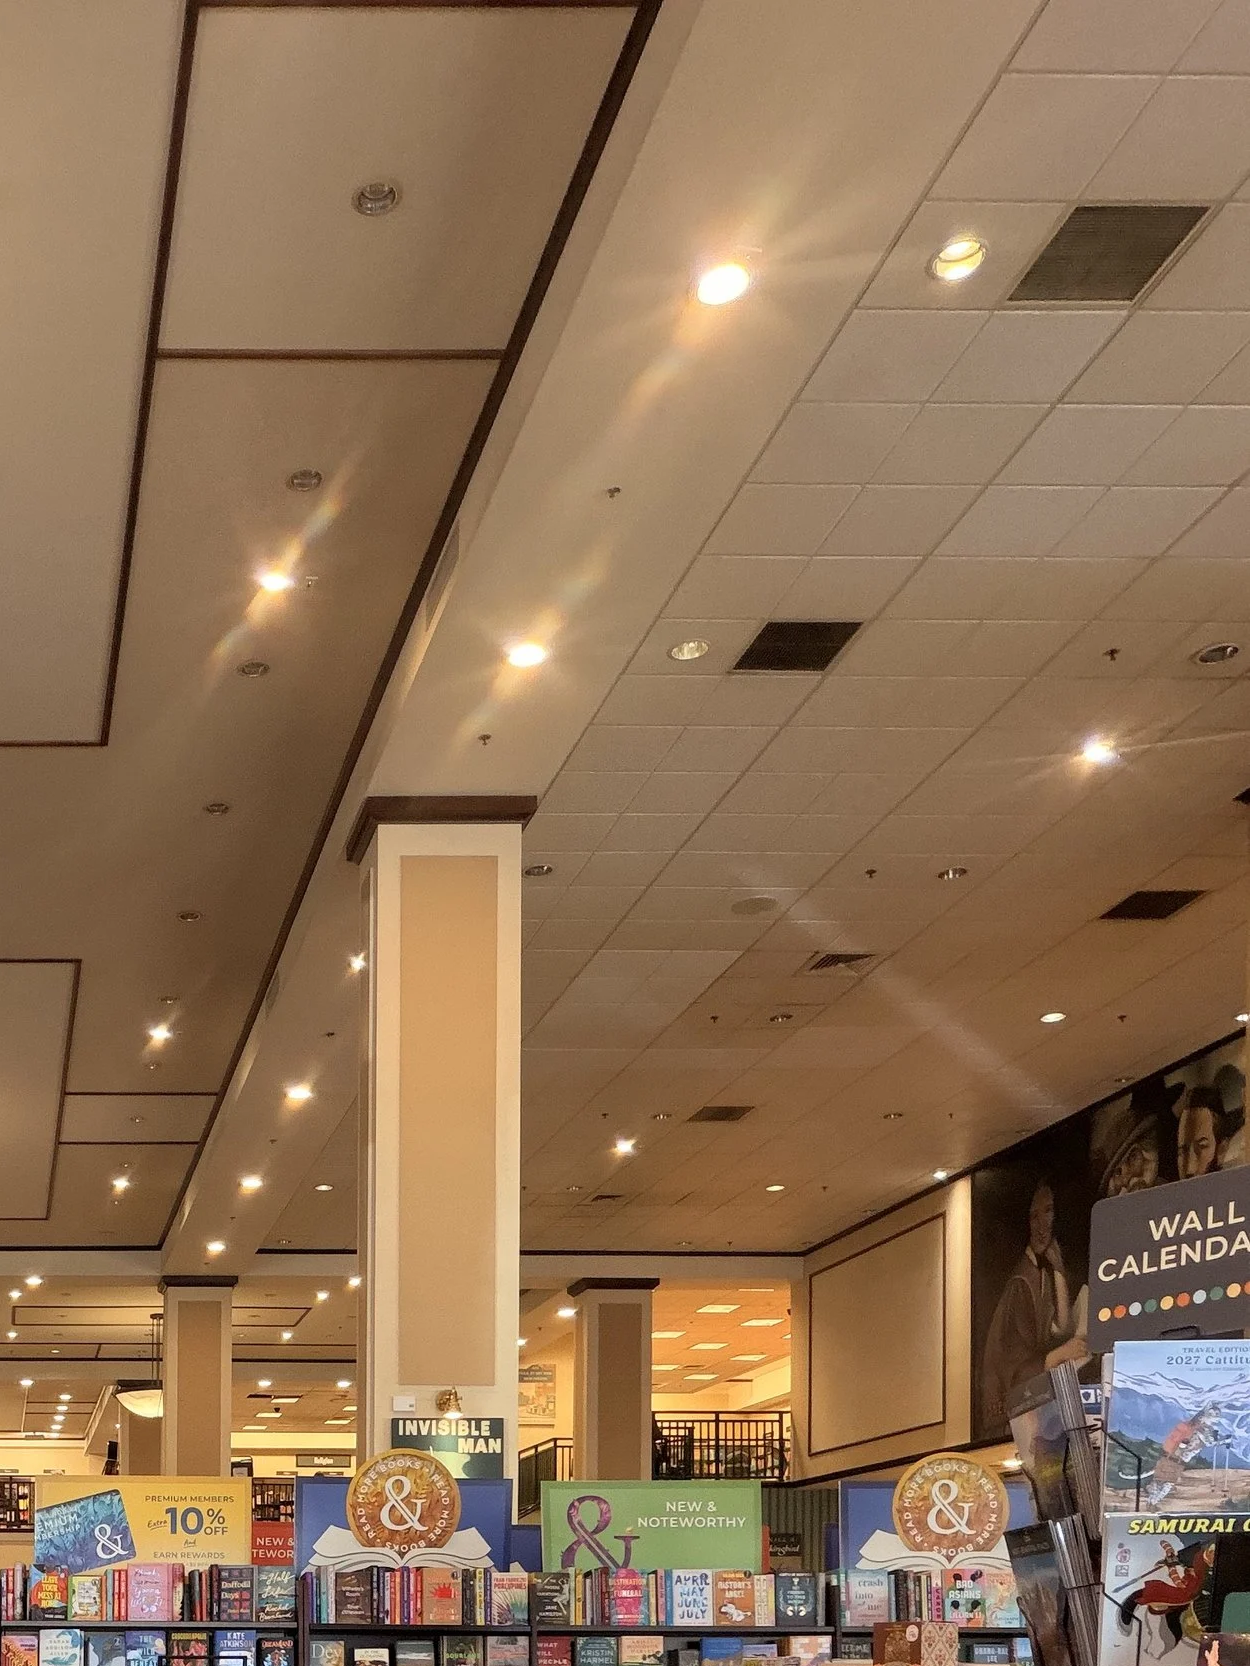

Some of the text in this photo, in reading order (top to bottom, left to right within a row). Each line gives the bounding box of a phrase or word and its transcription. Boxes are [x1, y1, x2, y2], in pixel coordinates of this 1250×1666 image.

[1149, 1201, 1246, 1241] WALL
[1166, 1355, 1200, 1366] 2027
[398, 1419, 491, 1436] INVISIBLE
[458, 1438, 502, 1454] MAN
[145, 1495, 235, 1503] PREMIUM MEMBERS
[666, 1501, 717, 1512] NEW &
[637, 1517, 746, 1528] NOTEWORTHY
[1128, 1518, 1236, 1535] SAMURAI
[204, 1526, 229, 1536] OFF
[256, 1537, 285, 1547] NEW
[153, 1551, 226, 1559] EARN REWARDS
[956, 1579, 974, 1589] BAD
[948, 1590, 982, 1599] ASIANS
[227, 1632, 246, 1641] KATE
[580, 1649, 615, 1657] KRISTIN
[580, 1657, 615, 1665] HARMEL
